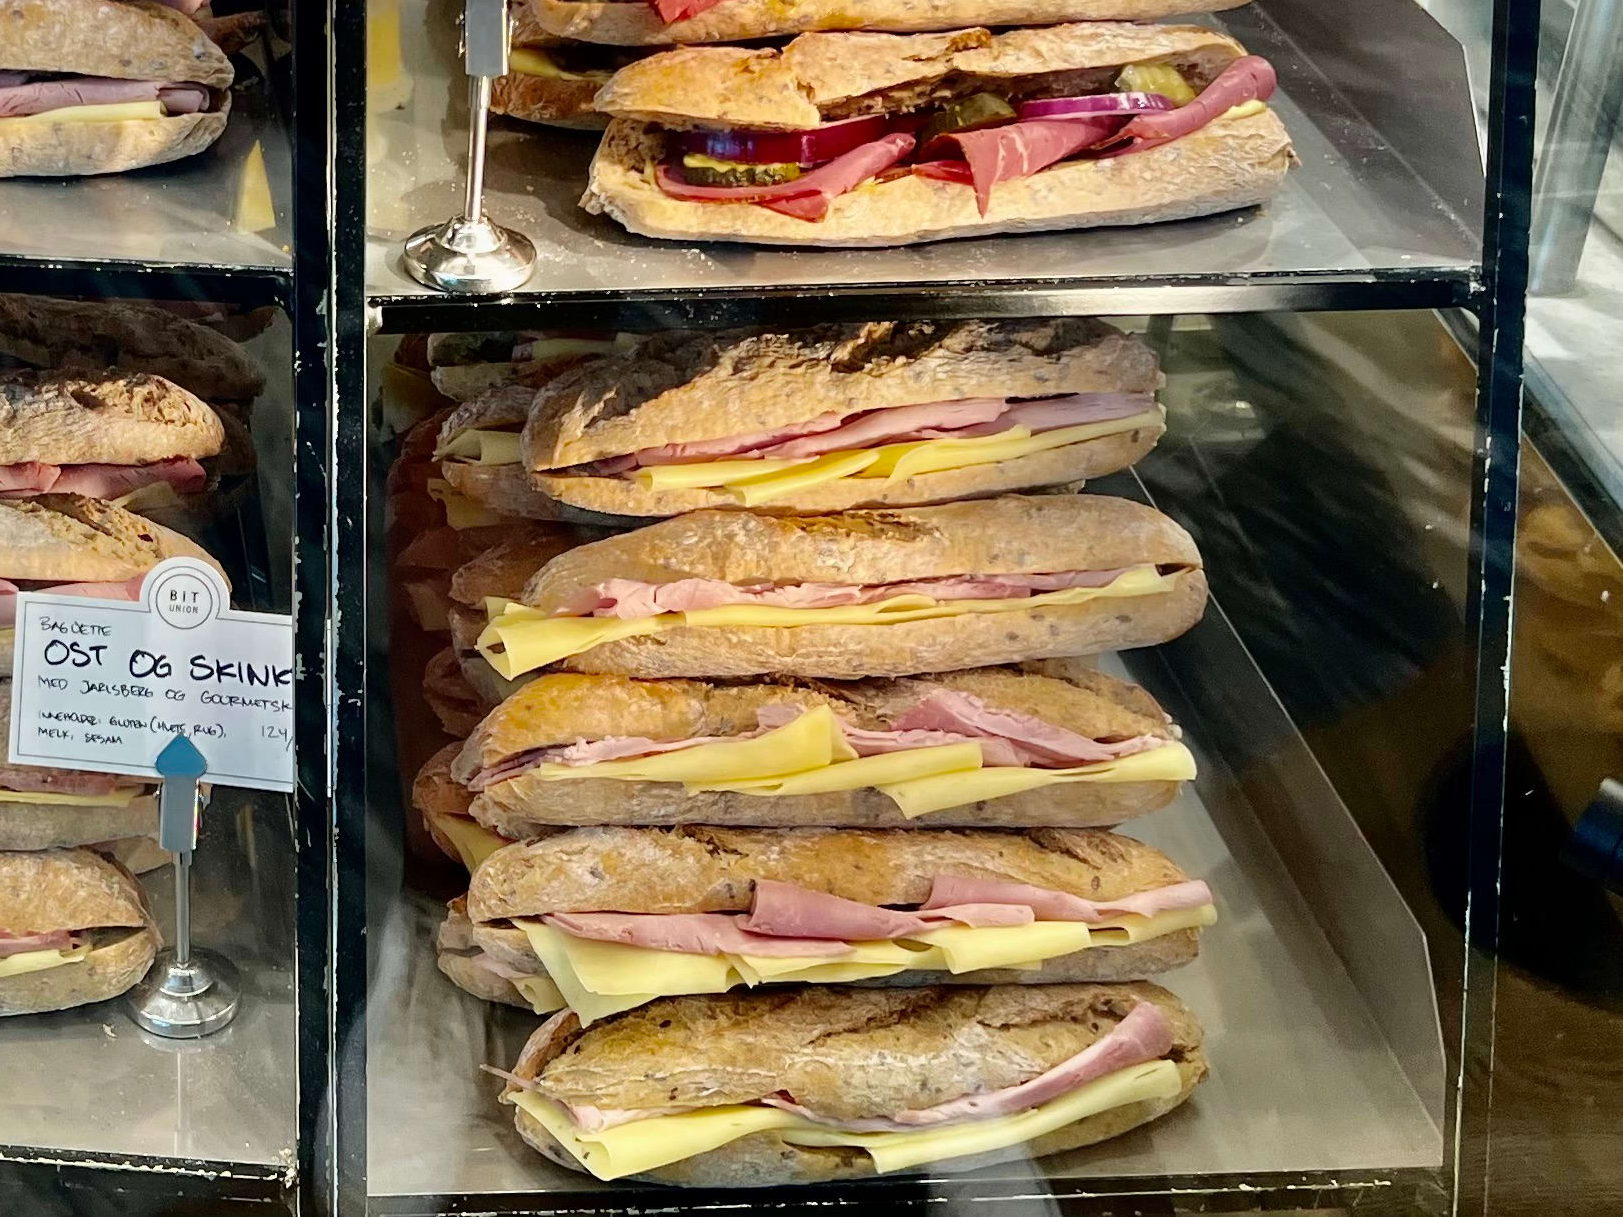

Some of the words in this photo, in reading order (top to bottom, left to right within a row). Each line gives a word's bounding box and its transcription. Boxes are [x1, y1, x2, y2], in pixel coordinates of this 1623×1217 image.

[169, 589, 199, 604] BIT
[168, 604, 200, 616] UNION
[44, 639, 108, 668] OST
[129, 648, 172, 679] OG
[37, 674, 68, 691] MED
[80, 679, 154, 699] JARLSBERG
[164, 687, 186, 702] OG
